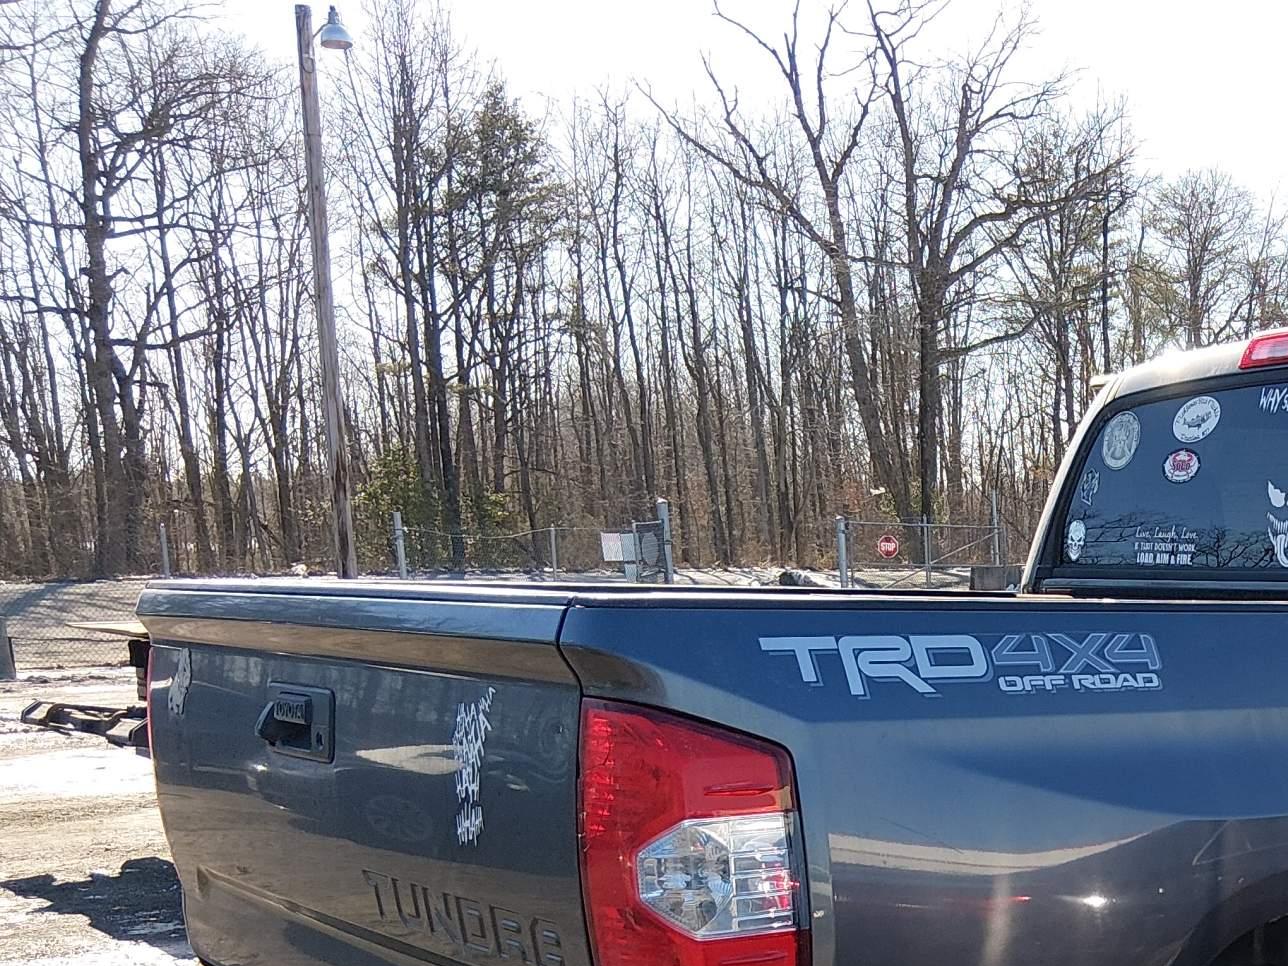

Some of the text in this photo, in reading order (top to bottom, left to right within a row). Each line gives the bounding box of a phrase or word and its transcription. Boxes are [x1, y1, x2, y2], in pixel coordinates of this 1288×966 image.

[1259, 387, 1287, 413] WHY
[880, 542, 896, 551] STOP
[1155, 553, 1169, 565] AIM
[758, 633, 1160, 696] TRD 4X4
[998, 672, 1160, 692] OFF ROAD
